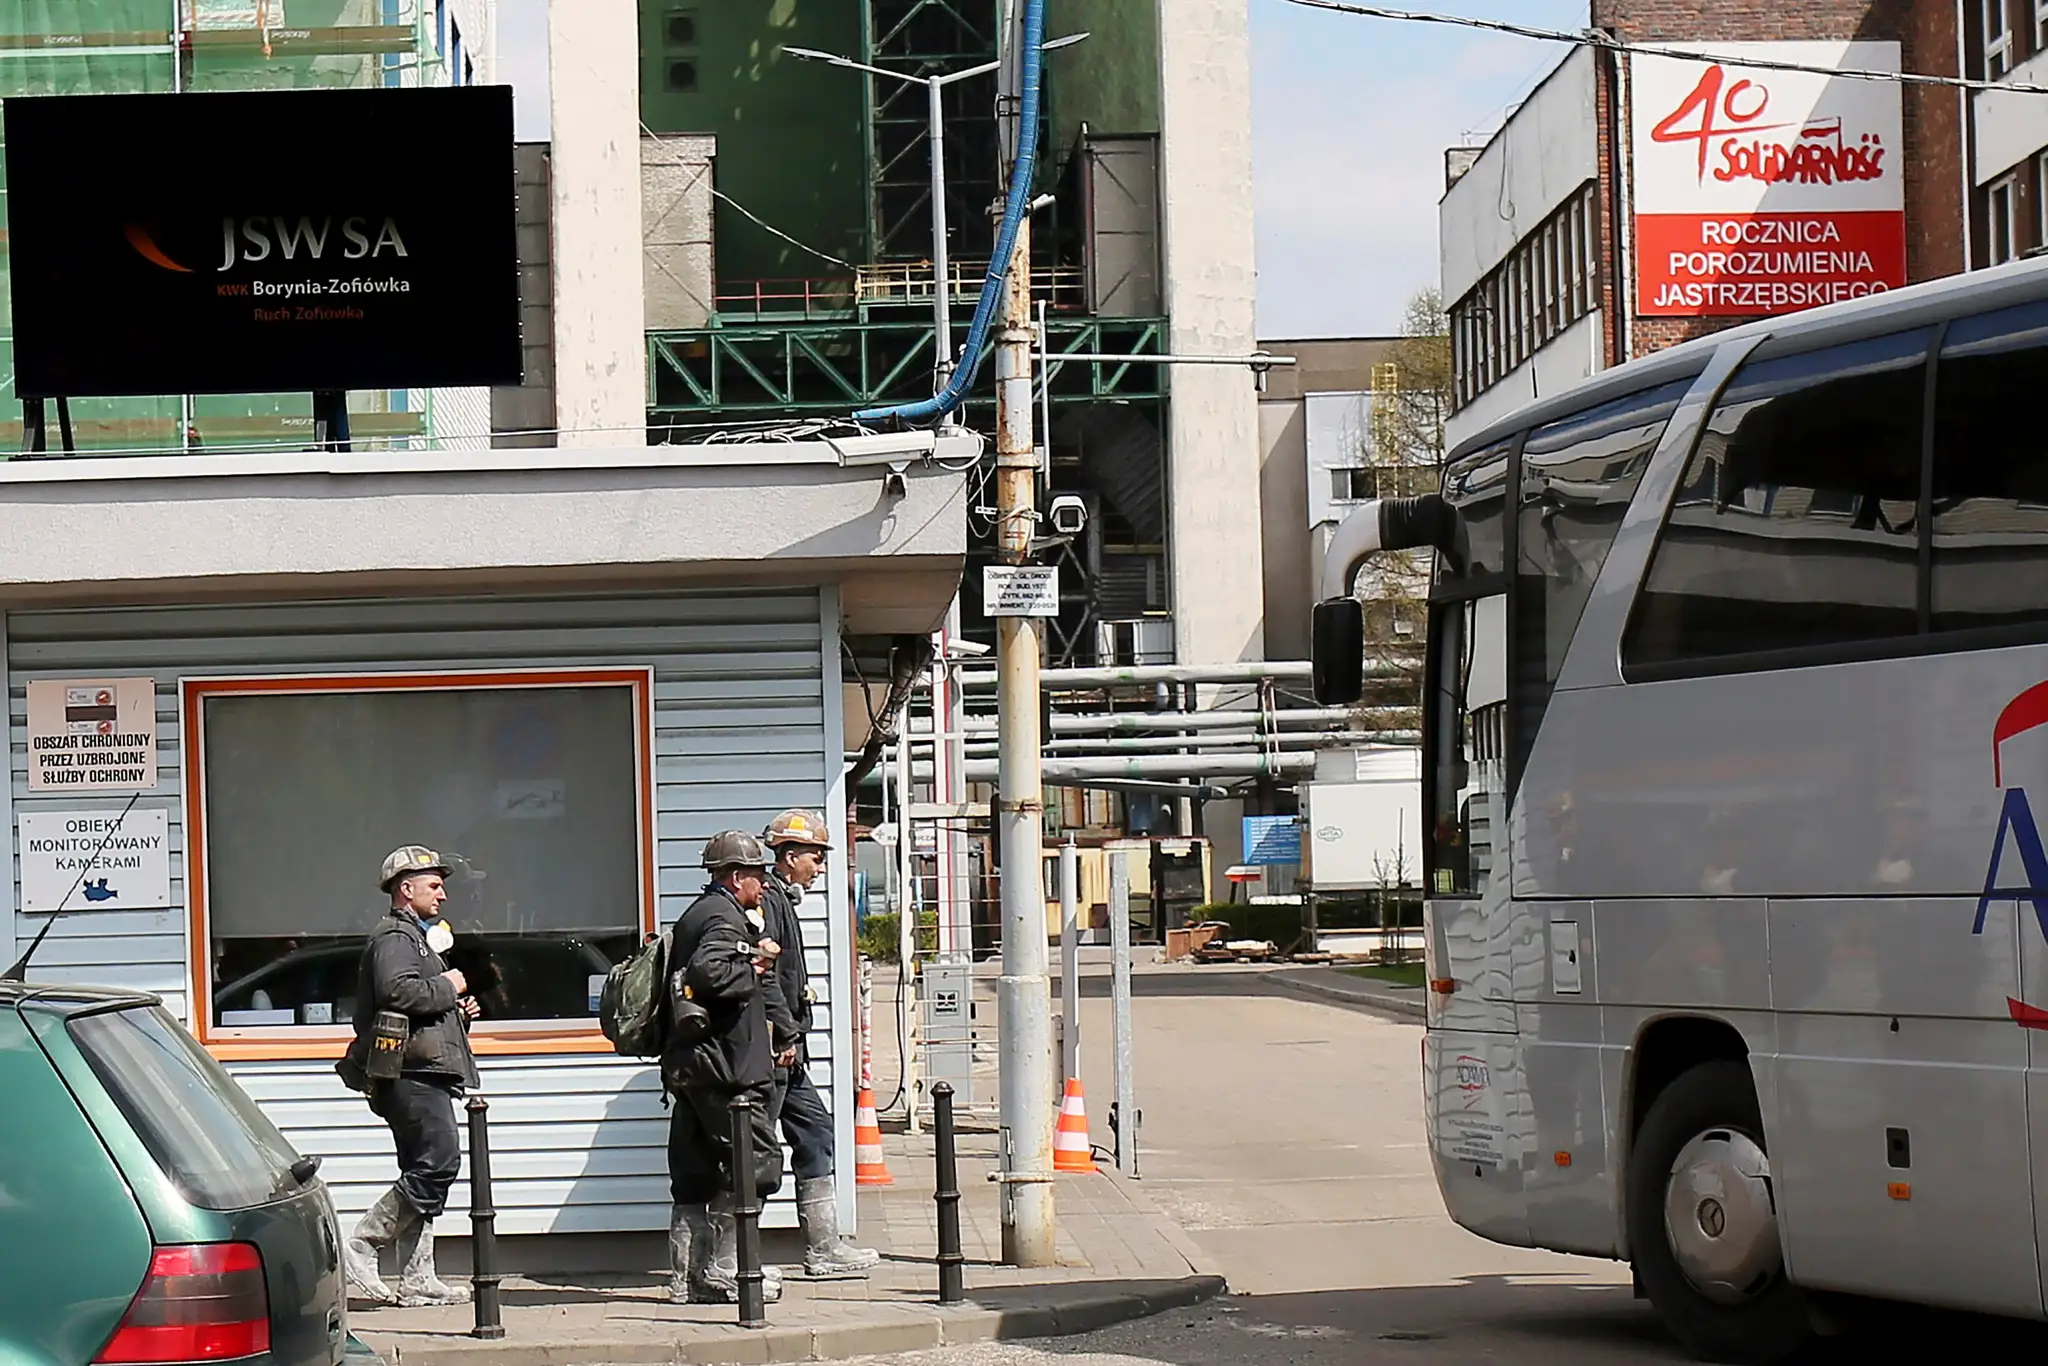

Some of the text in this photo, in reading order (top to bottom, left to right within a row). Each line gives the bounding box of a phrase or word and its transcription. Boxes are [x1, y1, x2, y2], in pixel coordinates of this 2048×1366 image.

[1651, 64, 1780, 188] 40
[1701, 220, 1840, 245] ROCZNICA
[216, 215, 409, 272] JSW SA
[1669, 251, 1874, 275] POROZUMIENIA
[217, 276, 410, 299] KWK Borynia-Zofiówka
[254, 305, 364, 321] Ruch Zofiówka
[33, 733, 151, 750] OBSZAR CHRONIONY
[39, 751, 146, 767] PRZEZ UZBROJONE
[43, 768, 145, 784] SŁUŻBY OCHRONY
[66, 819, 124, 833] OBIEKT
[29, 836, 161, 852] MONITOROWANY
[56, 856, 141, 870] KAMERAMI
